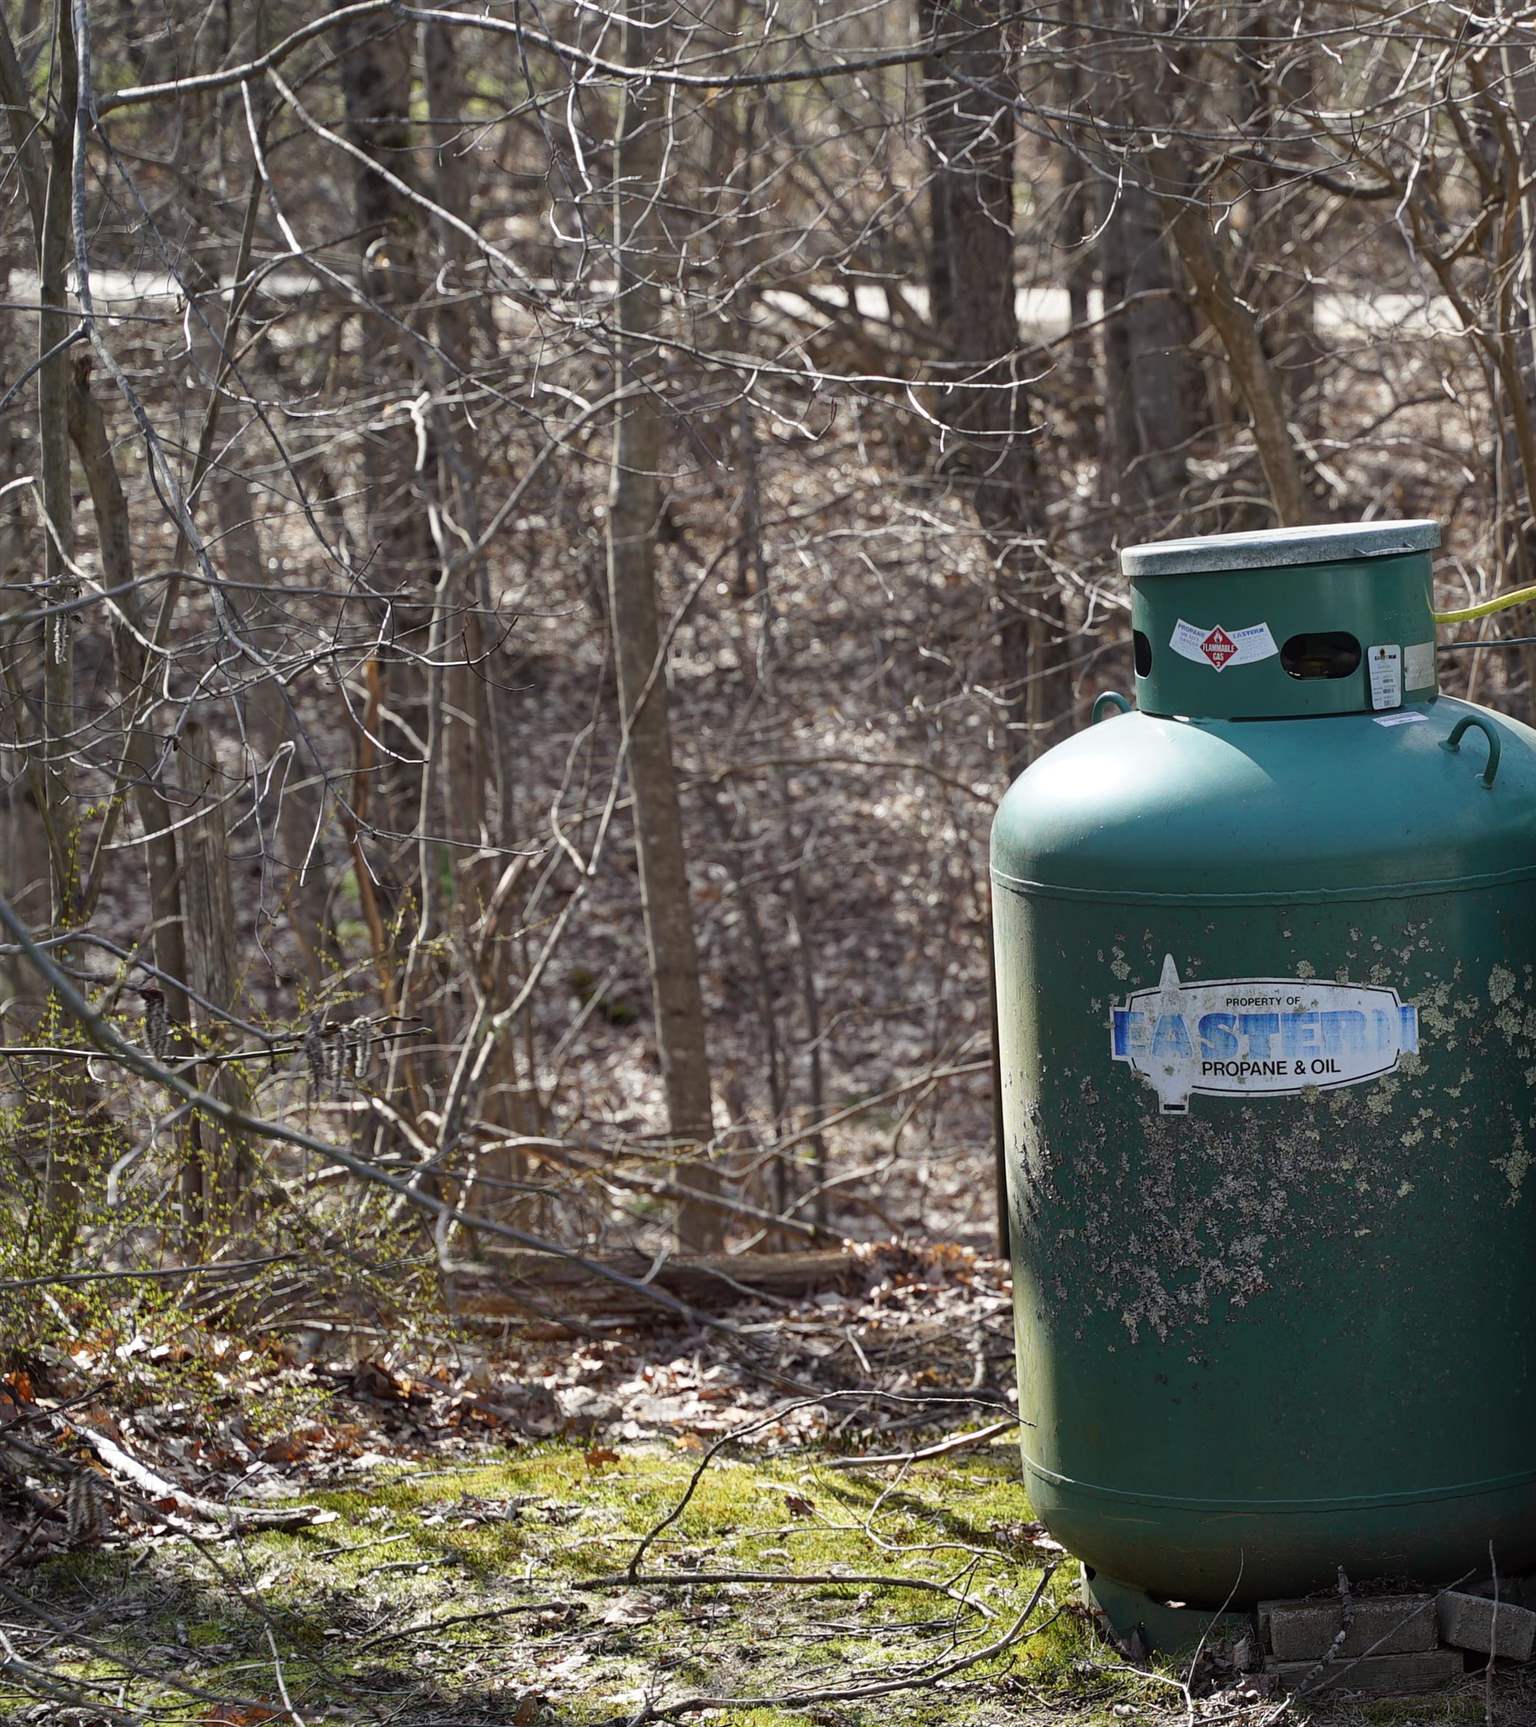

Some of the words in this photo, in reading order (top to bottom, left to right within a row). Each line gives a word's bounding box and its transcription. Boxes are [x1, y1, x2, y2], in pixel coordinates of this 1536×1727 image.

[1212, 652, 1224, 660] GAS
[1225, 997, 1282, 1007] PROPERTY
[1286, 996, 1301, 1006] OF
[1113, 1006, 1417, 1059] EASTERN
[1202, 1060, 1288, 1076] PROPANE
[1294, 1059, 1306, 1075] &
[1311, 1058, 1342, 1075] OIL
